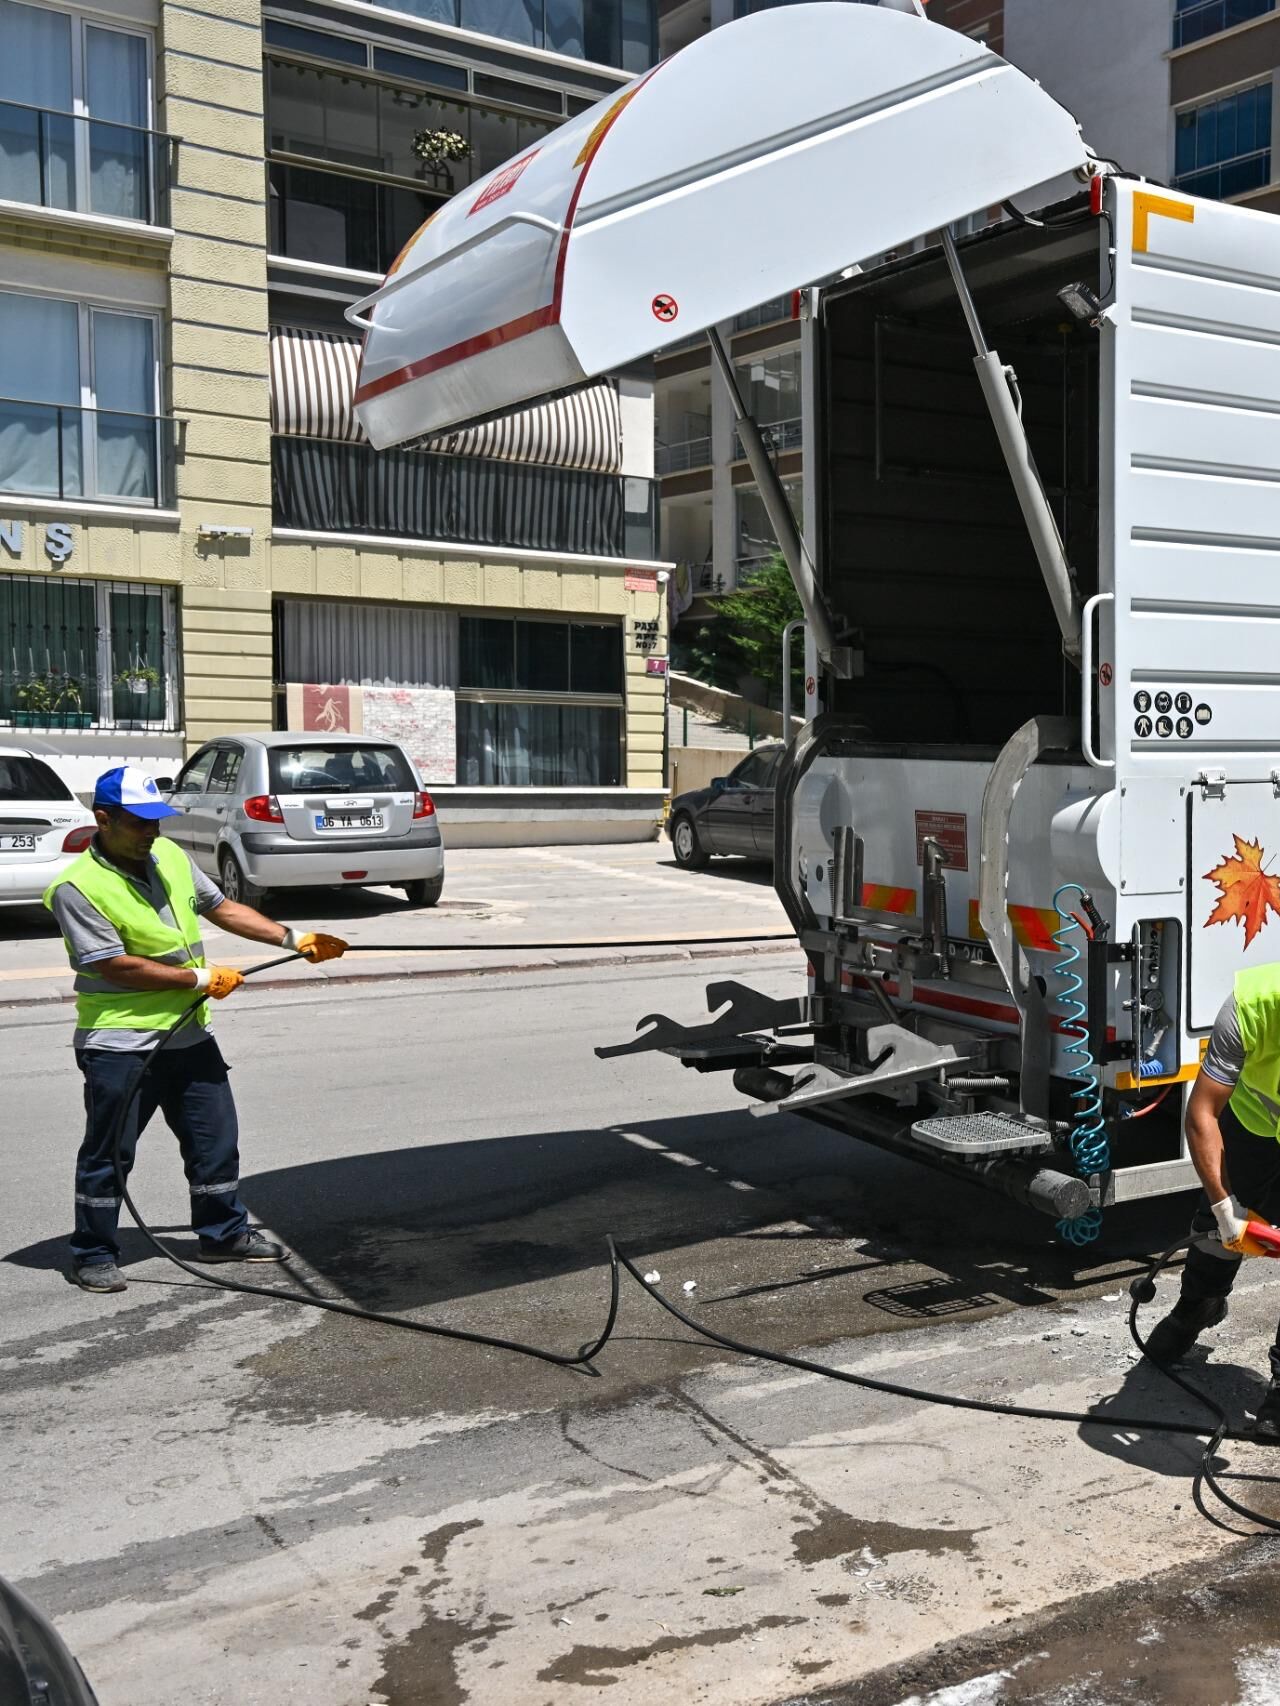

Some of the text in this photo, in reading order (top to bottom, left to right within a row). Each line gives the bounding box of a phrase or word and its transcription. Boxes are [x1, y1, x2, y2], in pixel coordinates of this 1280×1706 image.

[634, 621, 659, 632] PAŞA
[635, 641, 657, 649] NO:7
[654, 660, 659, 669] 7
[322, 816, 334, 828] 06
[341, 815, 352, 827] YA
[11, 835, 33, 848] 253
